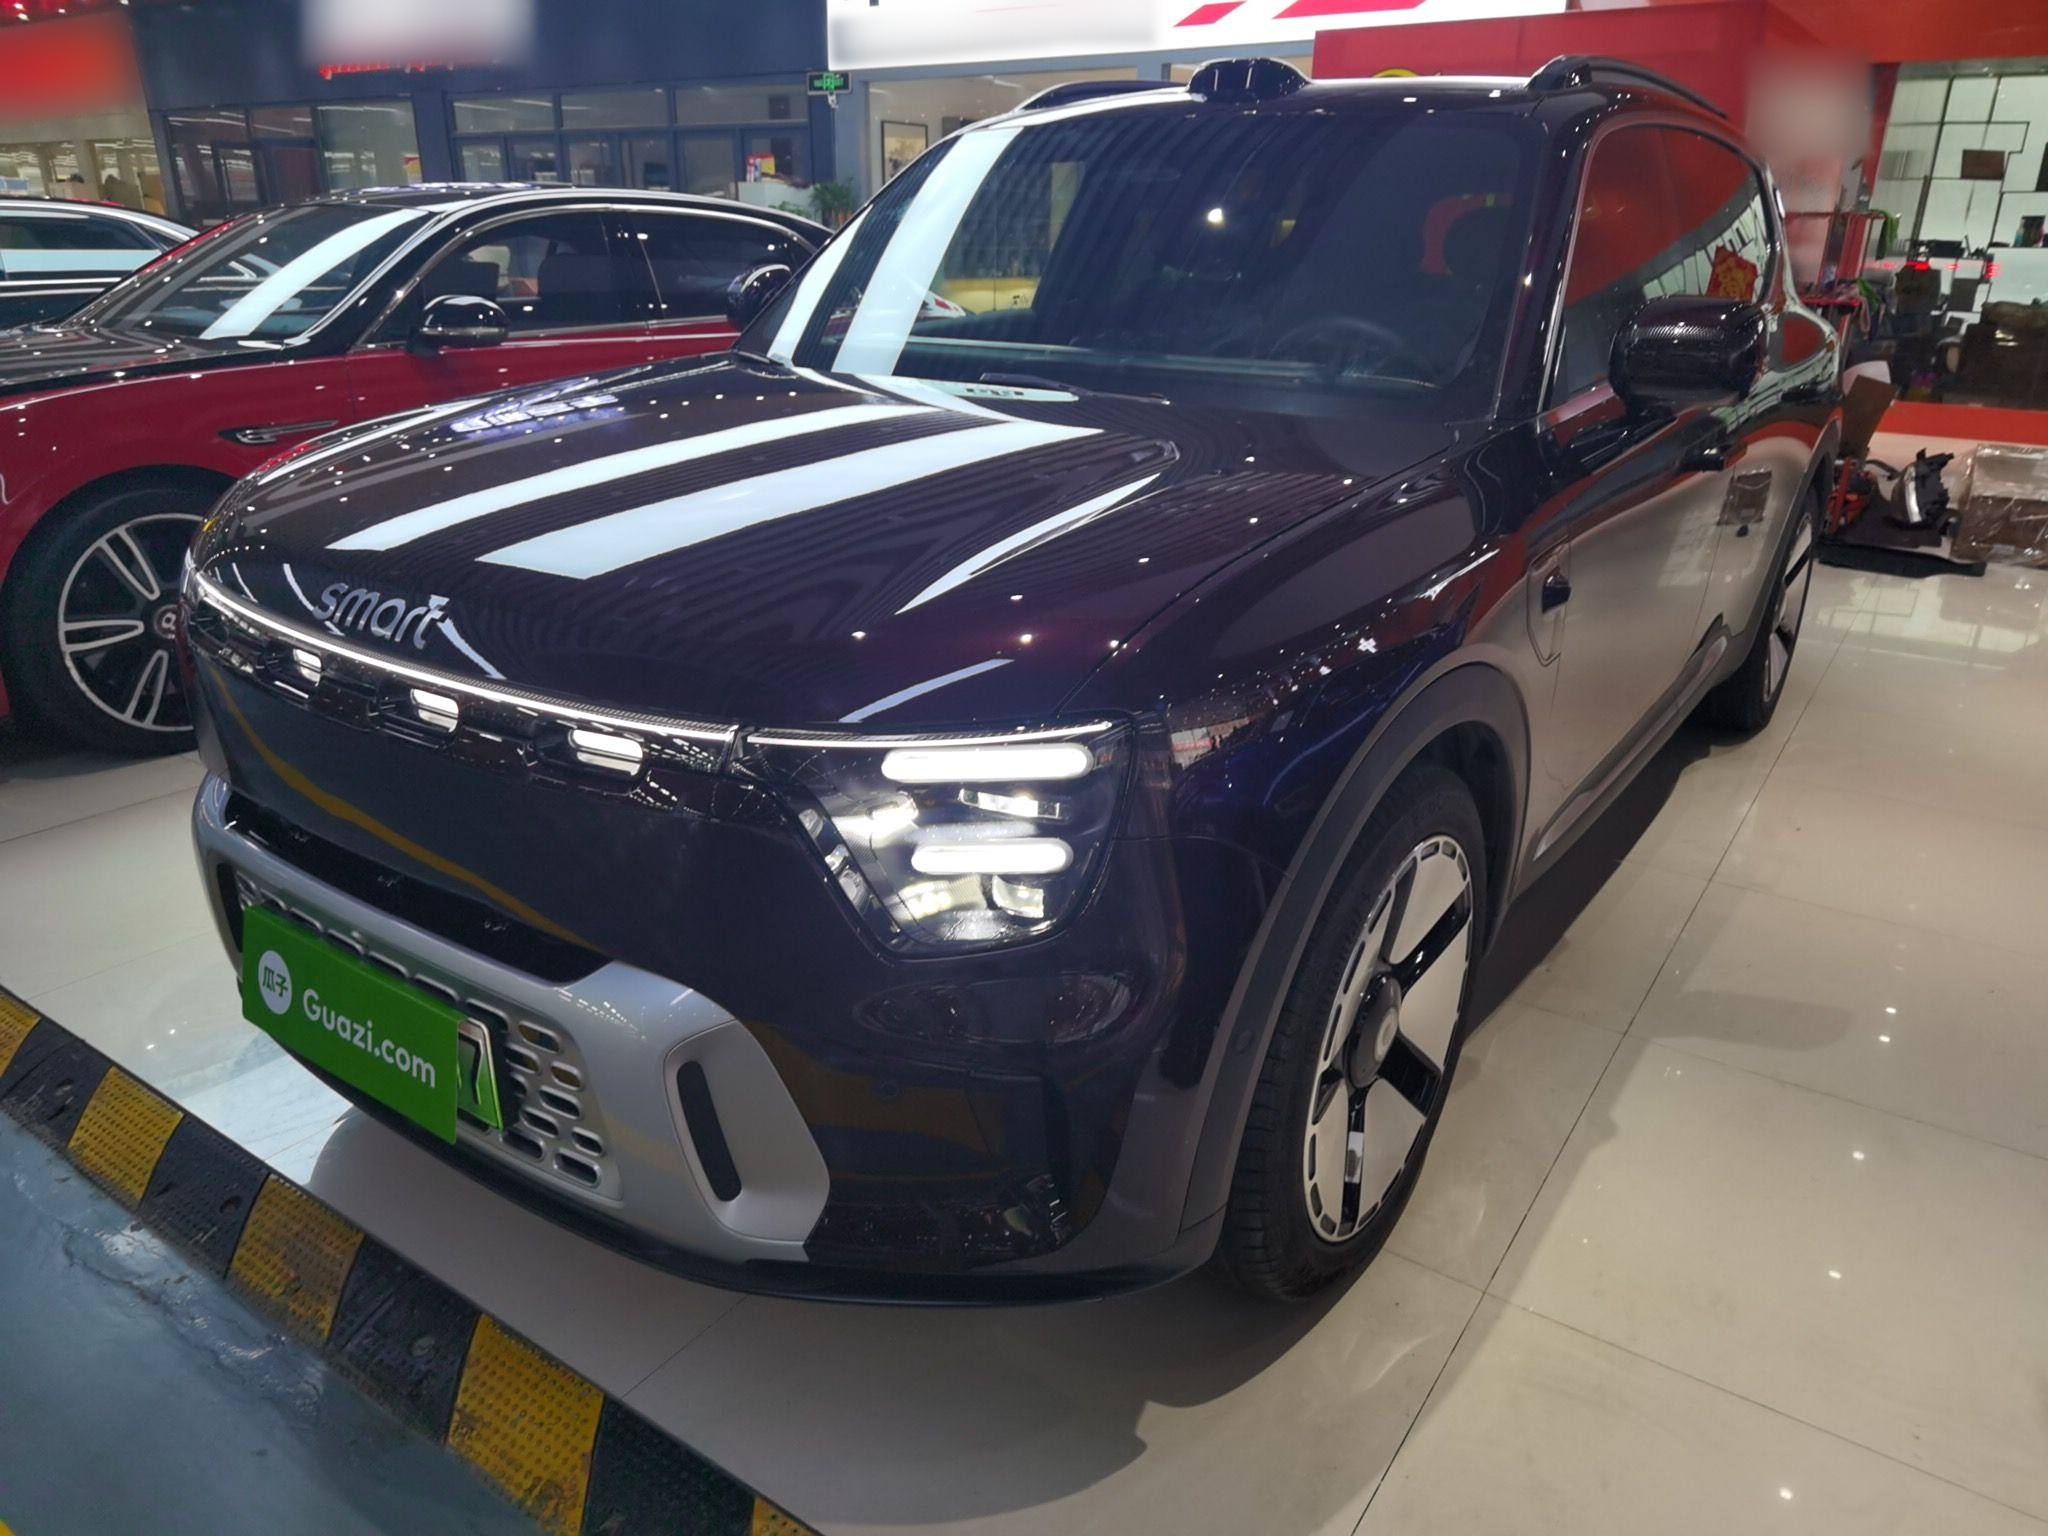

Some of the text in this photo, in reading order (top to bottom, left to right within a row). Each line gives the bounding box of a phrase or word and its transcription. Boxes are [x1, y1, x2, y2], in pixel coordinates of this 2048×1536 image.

[312, 583, 448, 650] smart
[262, 965, 289, 998] 瓜子
[303, 988, 436, 1089] Guazi.com
